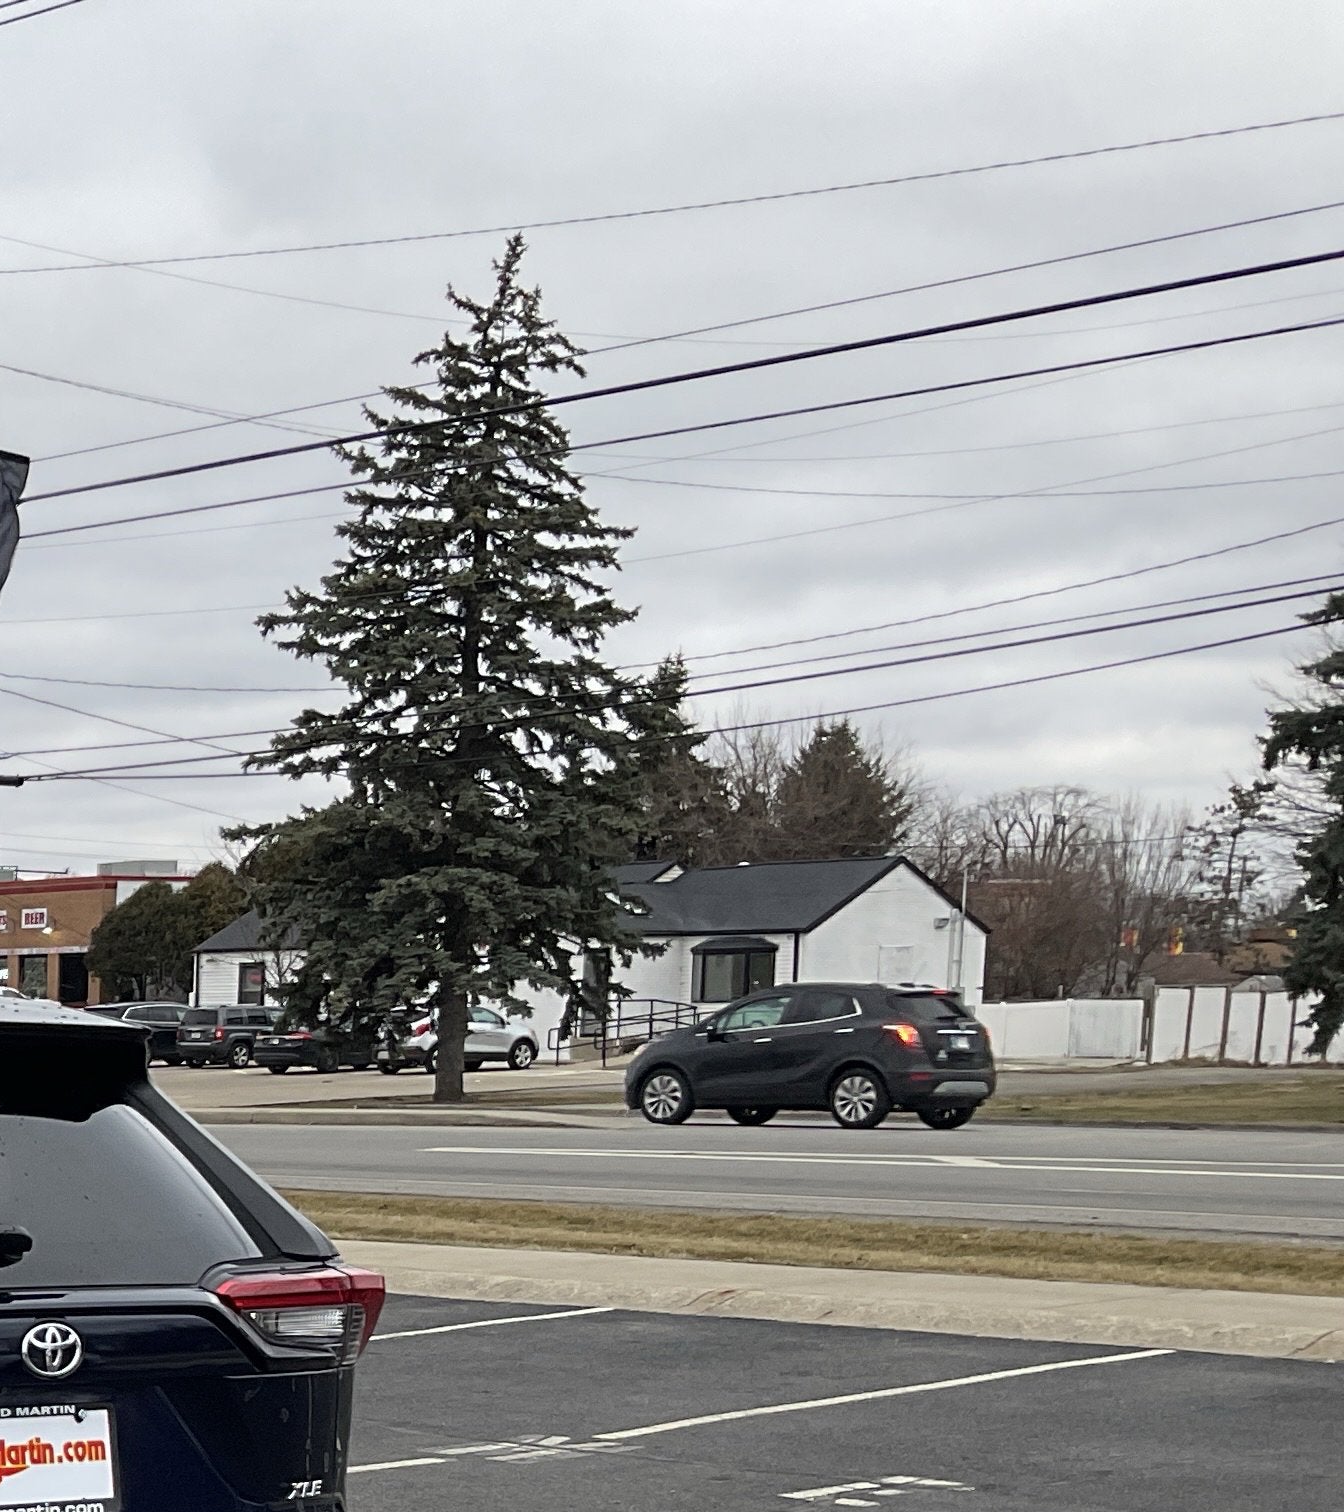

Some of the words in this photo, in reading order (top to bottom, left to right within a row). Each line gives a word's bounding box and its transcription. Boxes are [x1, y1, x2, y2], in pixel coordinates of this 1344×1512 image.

[24, 912, 45, 925] BEER
[15, 1405, 76, 1417] MARTIN
[287, 1480, 322, 1499] XLE
